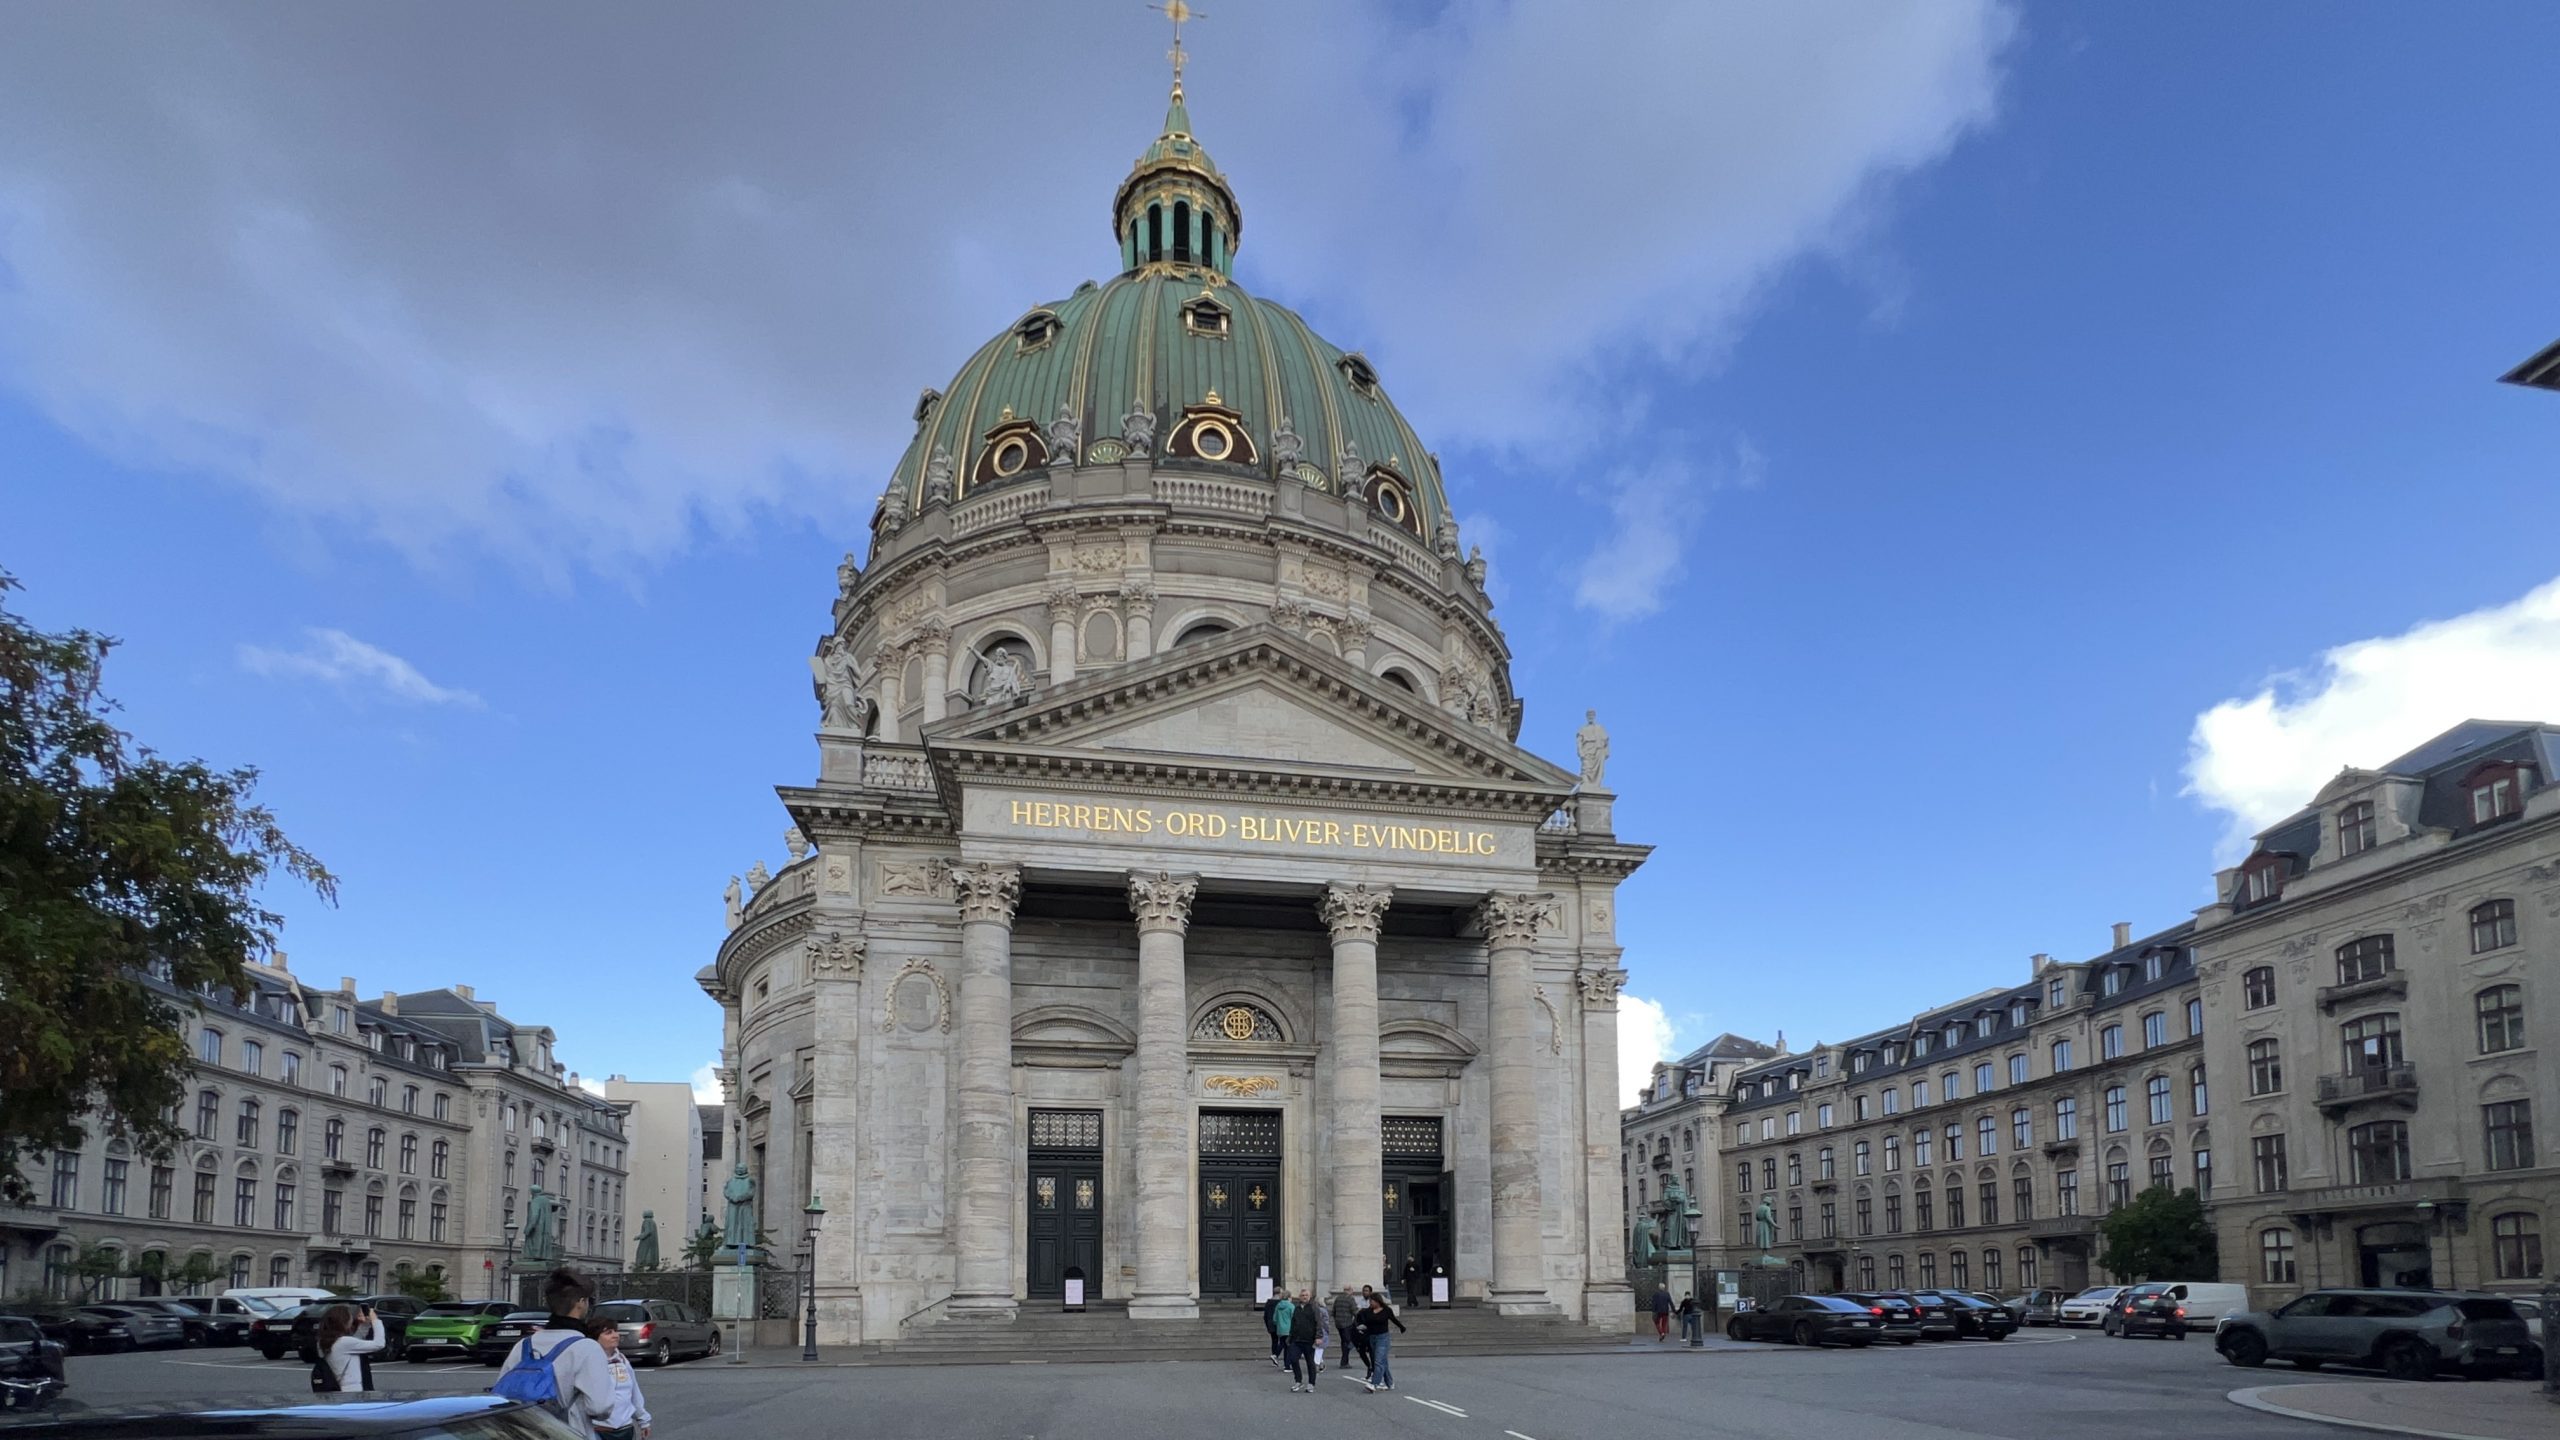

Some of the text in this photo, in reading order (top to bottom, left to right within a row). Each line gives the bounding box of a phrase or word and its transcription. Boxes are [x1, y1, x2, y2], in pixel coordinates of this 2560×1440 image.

[1011, 800, 1496, 855] HERRENS ORD BLIVER EVINDELIG
